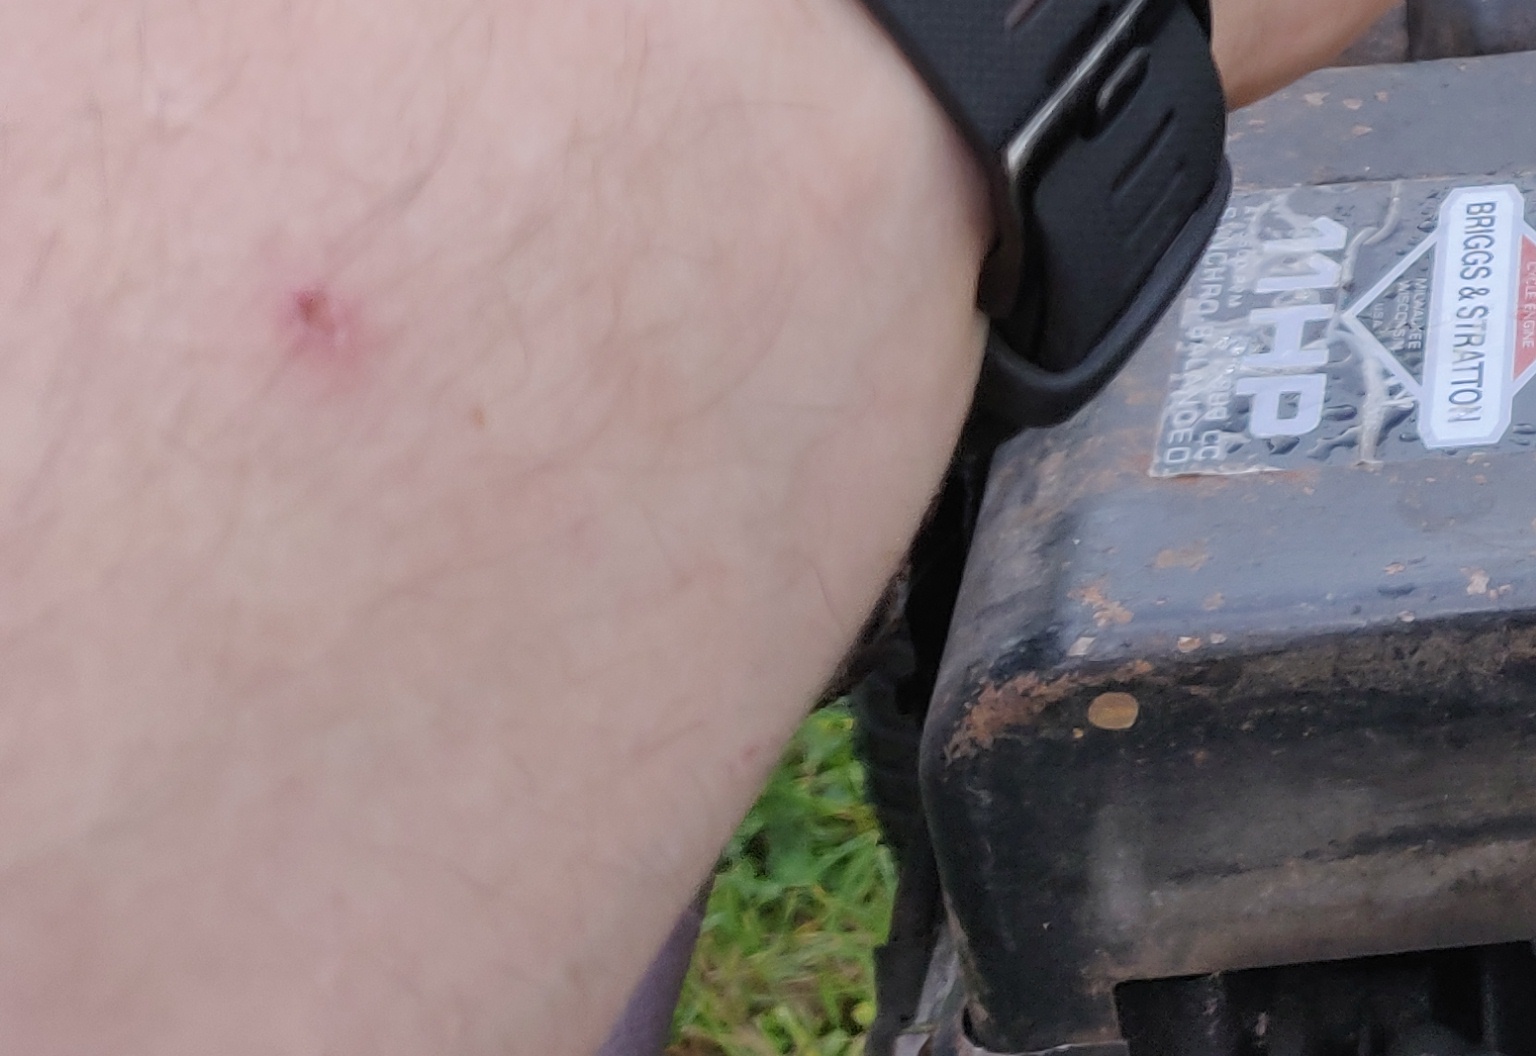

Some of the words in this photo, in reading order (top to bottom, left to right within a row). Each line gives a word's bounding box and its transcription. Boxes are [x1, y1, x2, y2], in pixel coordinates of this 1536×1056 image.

[1459, 201, 1497, 280] BRIGGS
[1407, 277, 1428, 350] MILWAUKEE
[1458, 287, 1490, 302] &
[1522, 303, 1536, 349] ENGINE
[1447, 305, 1489, 423] STRATTON
